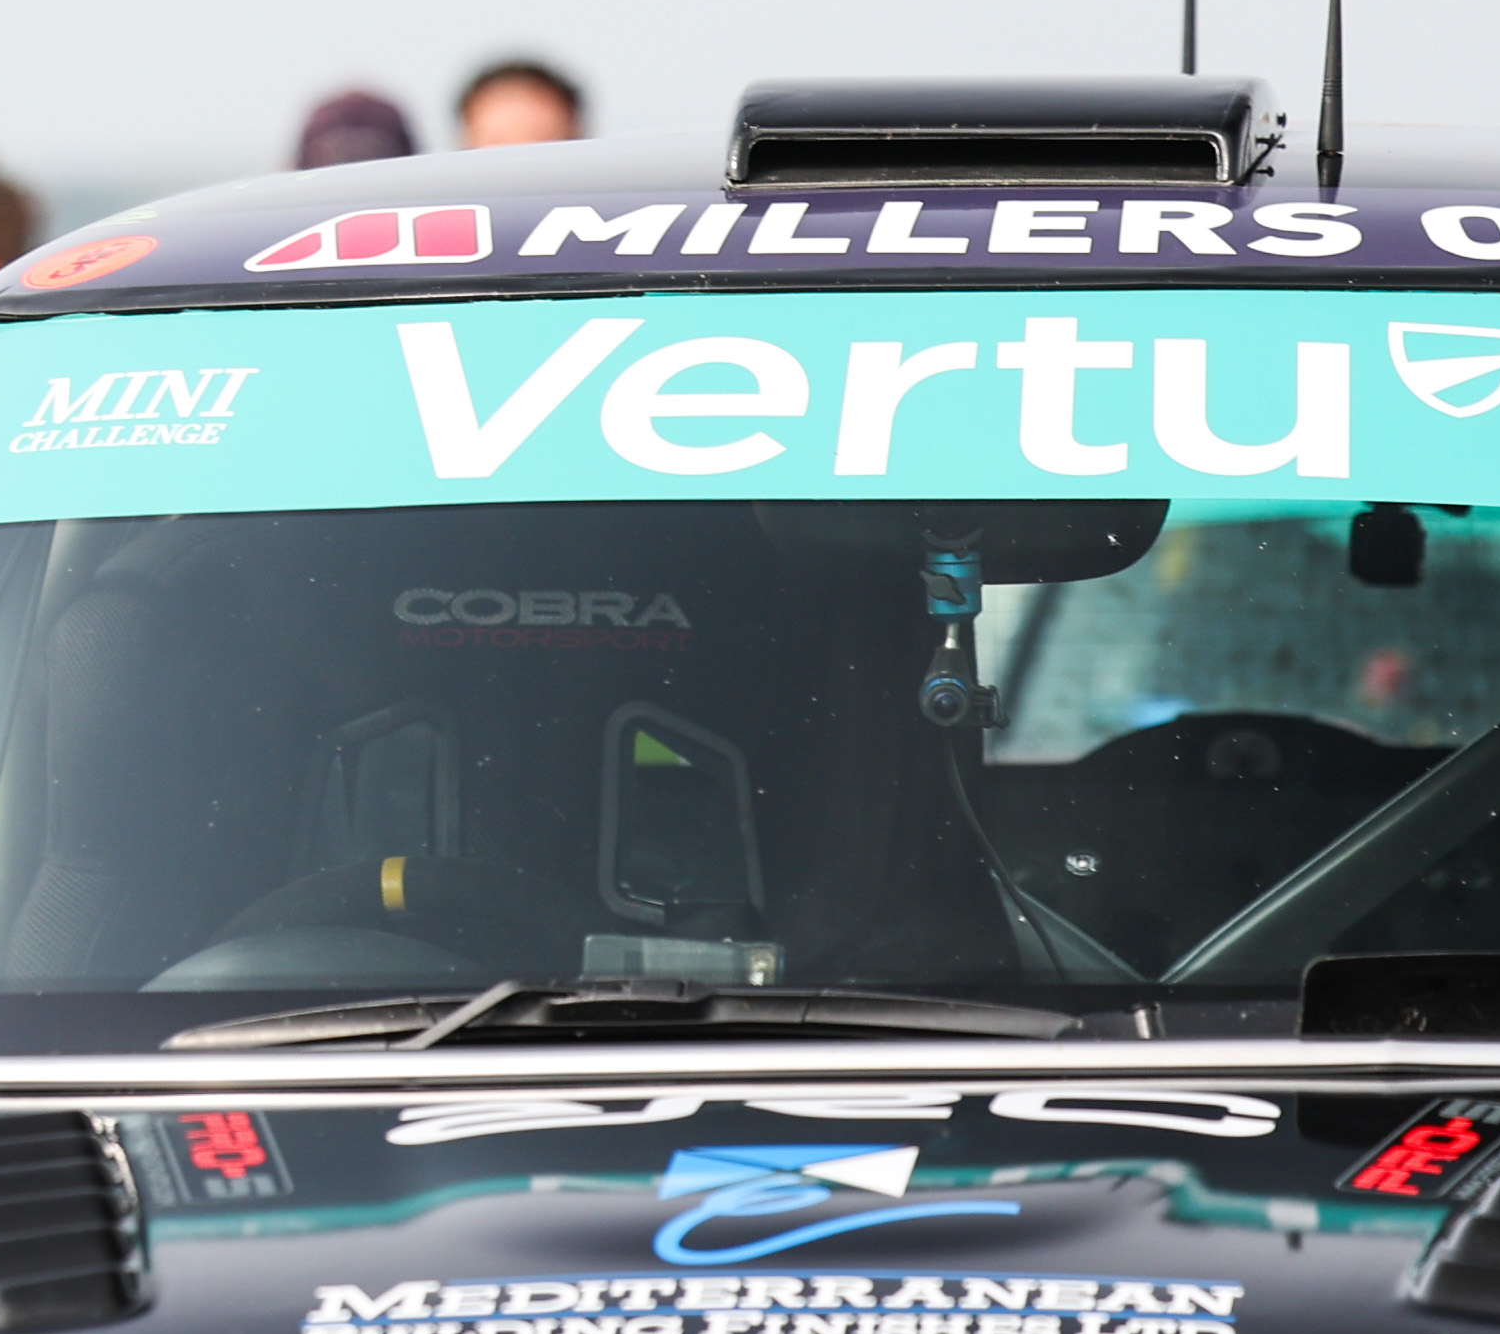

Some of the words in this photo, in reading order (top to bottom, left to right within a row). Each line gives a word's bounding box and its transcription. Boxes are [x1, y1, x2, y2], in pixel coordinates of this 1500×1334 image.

[518, 200, 1363, 256] MILLERS
[21, 367, 260, 427] MINI
[396, 315, 1351, 479] Vertu
[9, 422, 228, 454] CHALLENGE
[393, 588, 692, 628] COBRA
[399, 628, 694, 652] MOTORSPORT
